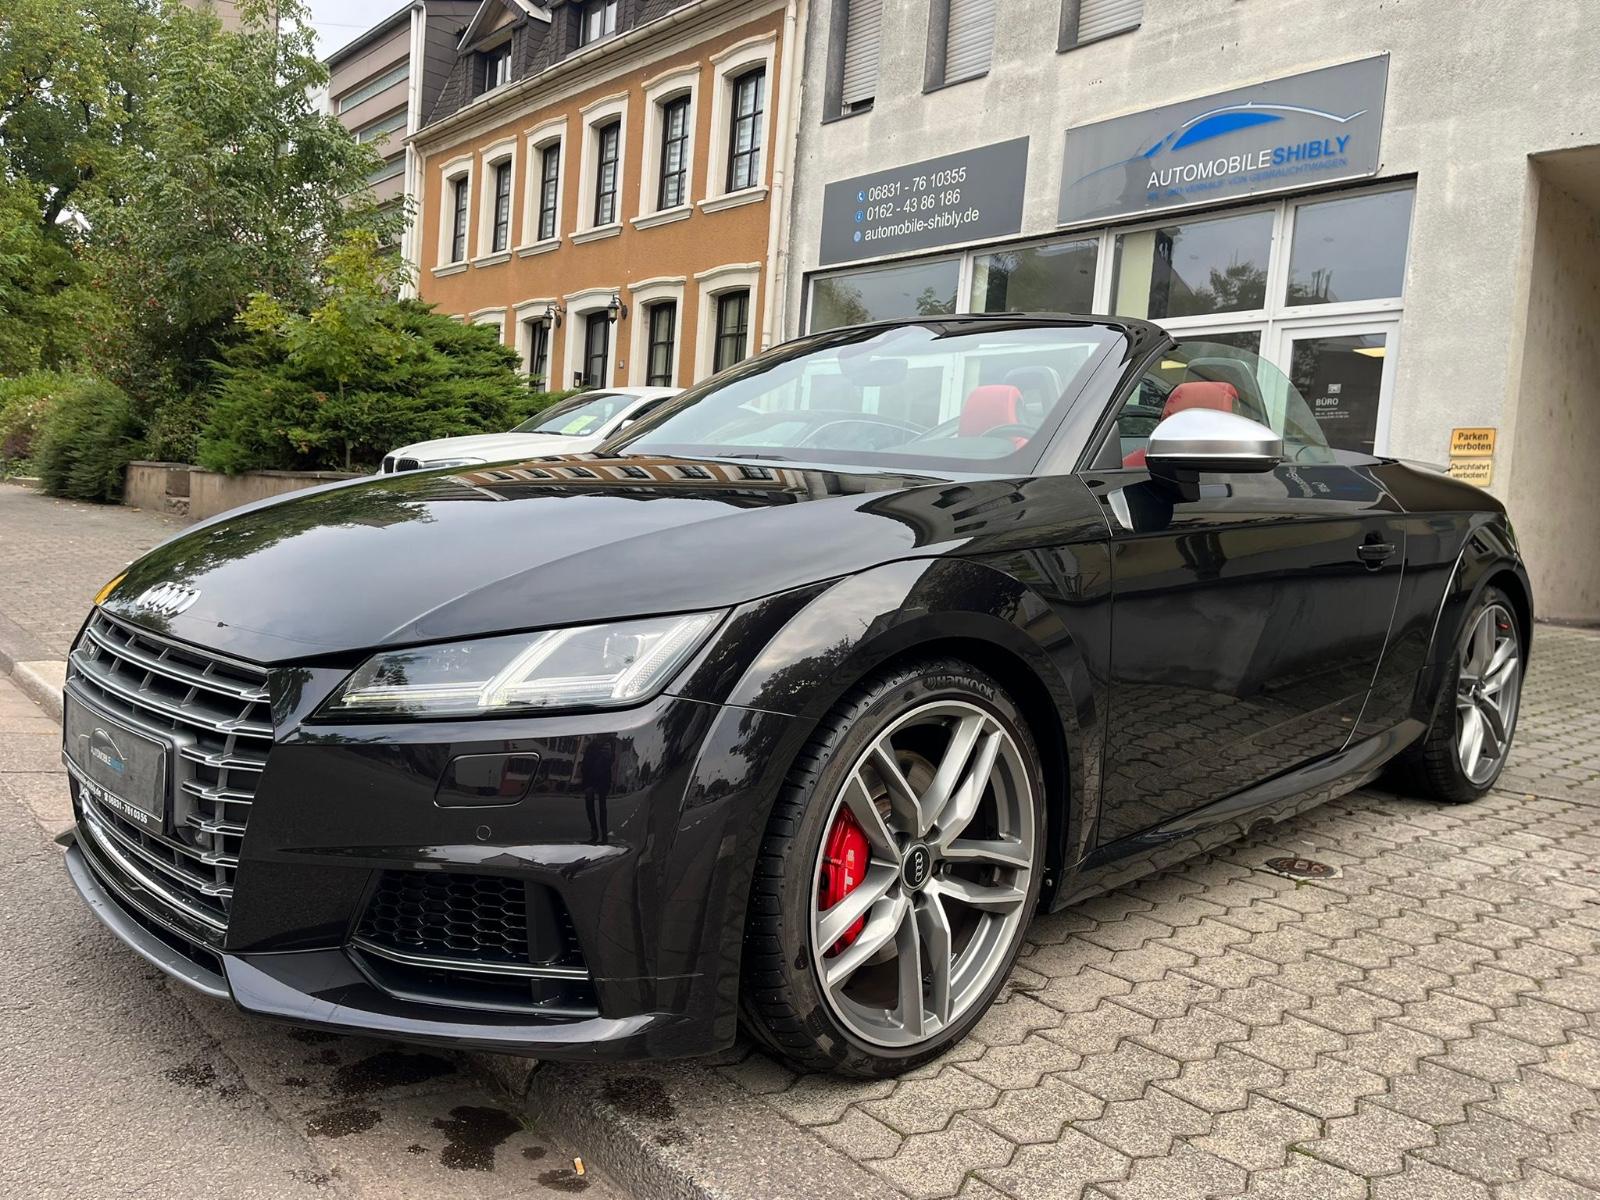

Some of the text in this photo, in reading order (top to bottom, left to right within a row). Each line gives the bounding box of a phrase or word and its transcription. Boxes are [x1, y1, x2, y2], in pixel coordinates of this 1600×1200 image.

[868, 181, 900, 201] 06831
[912, 176, 926, 192] 76
[930, 166, 967, 188] 10355
[866, 203, 894, 221] 0162
[903, 197, 918, 213] 43
[920, 194, 935, 210] 86
[939, 188, 961, 206] 186
[864, 207, 980, 241] automobile-shibly.de
[1315, 397, 1339, 406] BÜRO
[1453, 442, 1492, 450] verboten
[1458, 432, 1489, 441] Parken
